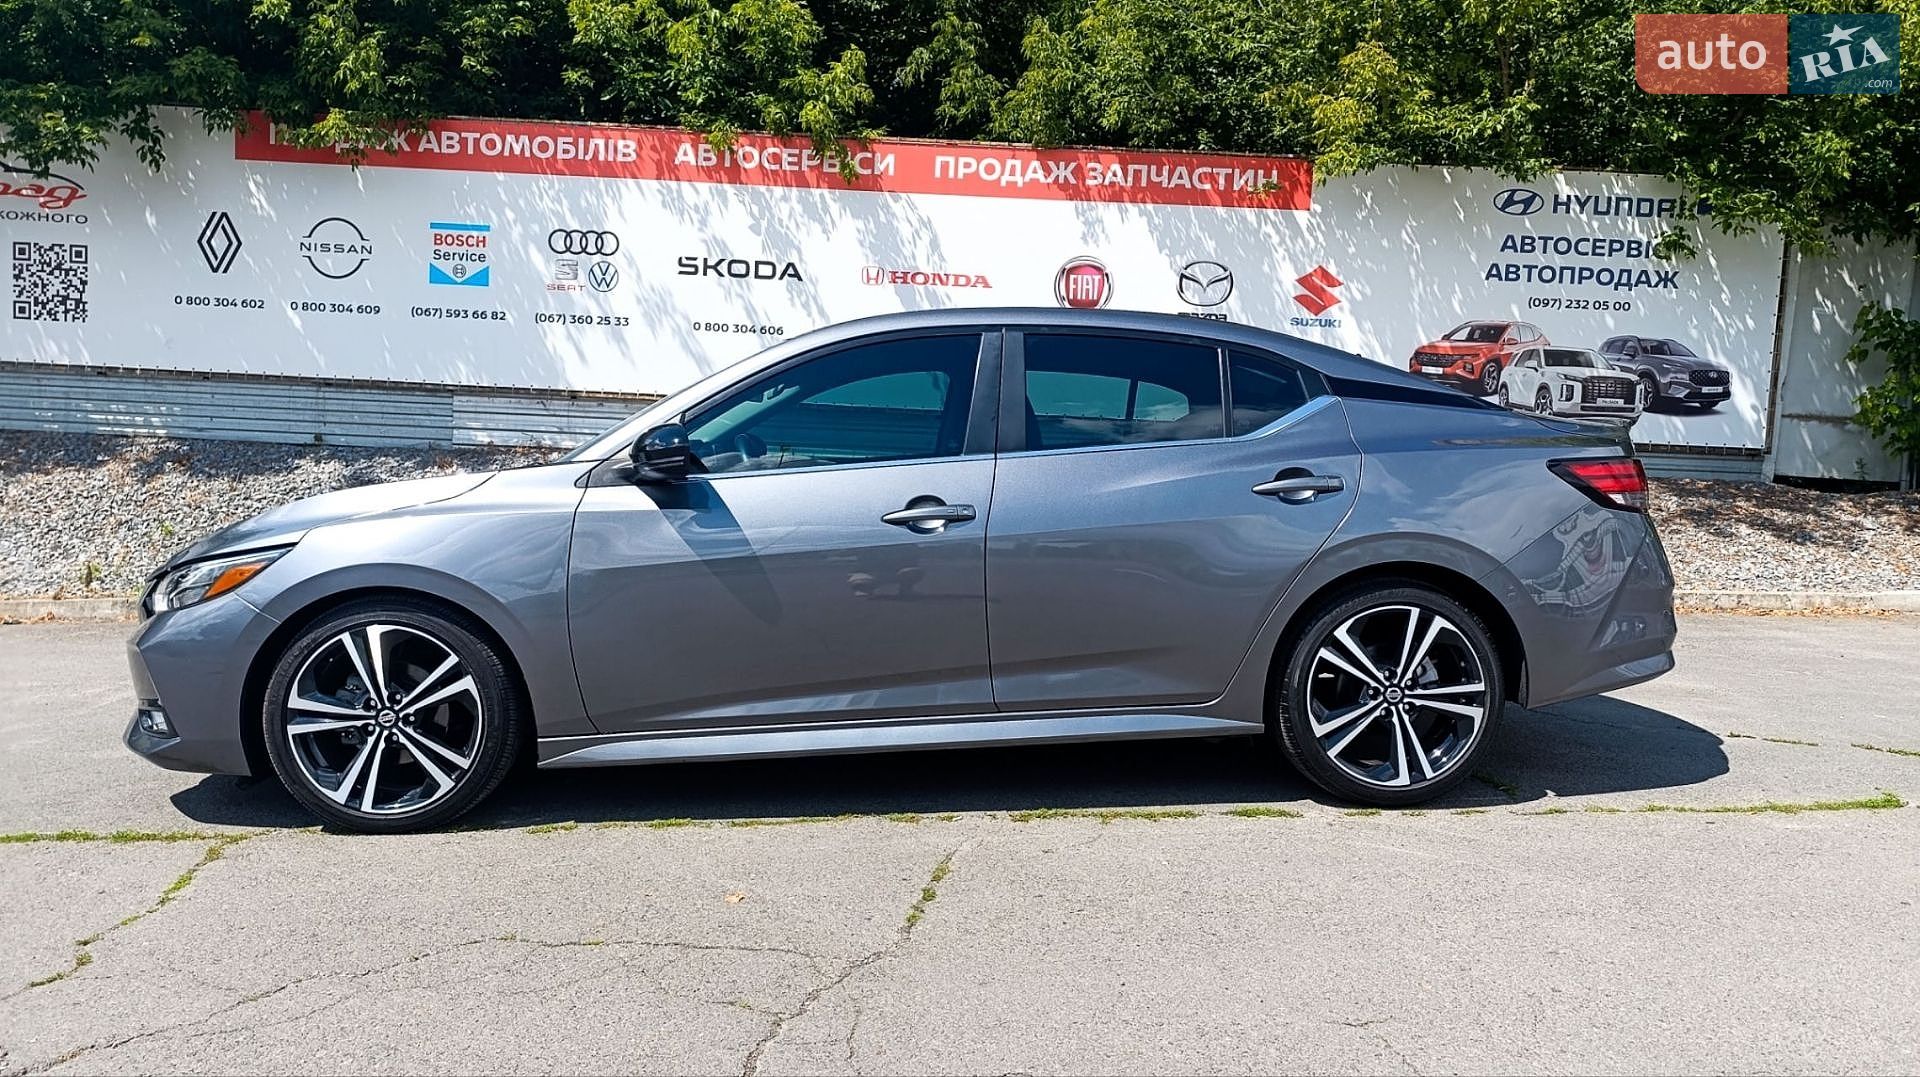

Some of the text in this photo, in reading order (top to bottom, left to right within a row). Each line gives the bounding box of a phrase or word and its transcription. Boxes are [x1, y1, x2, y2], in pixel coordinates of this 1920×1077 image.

[417, 130, 638, 162] АВТОМОБІЛІВ
[934, 155, 1279, 193] ПРОДАЖ ЗАПЧАСТИН
[1552, 194, 1691, 219] HYUNDA
[433, 233, 487, 248] BOSCH
[1500, 234, 1662, 260] АВТОСЕРВІ
[300, 242, 373, 255] NISSAN
[433, 249, 487, 263] Service
[888, 270, 993, 289] HONDA
[1485, 263, 1680, 292] АВТОПРОДАЖ
[546, 283, 587, 292] SEAT
[1069, 274, 1101, 300] FIAT
[174, 296, 265, 309] 0 800 304 602
[290, 301, 381, 315] 0 800 304 609
[1528, 297, 1631, 312] (097) 232 05 00
[411, 306, 507, 321] (067) 593 66 82
[535, 312, 630, 327] (067) 360 25 33
[693, 321, 784, 336] 0 800 304 606
[1289, 317, 1342, 329] SUZUKI
